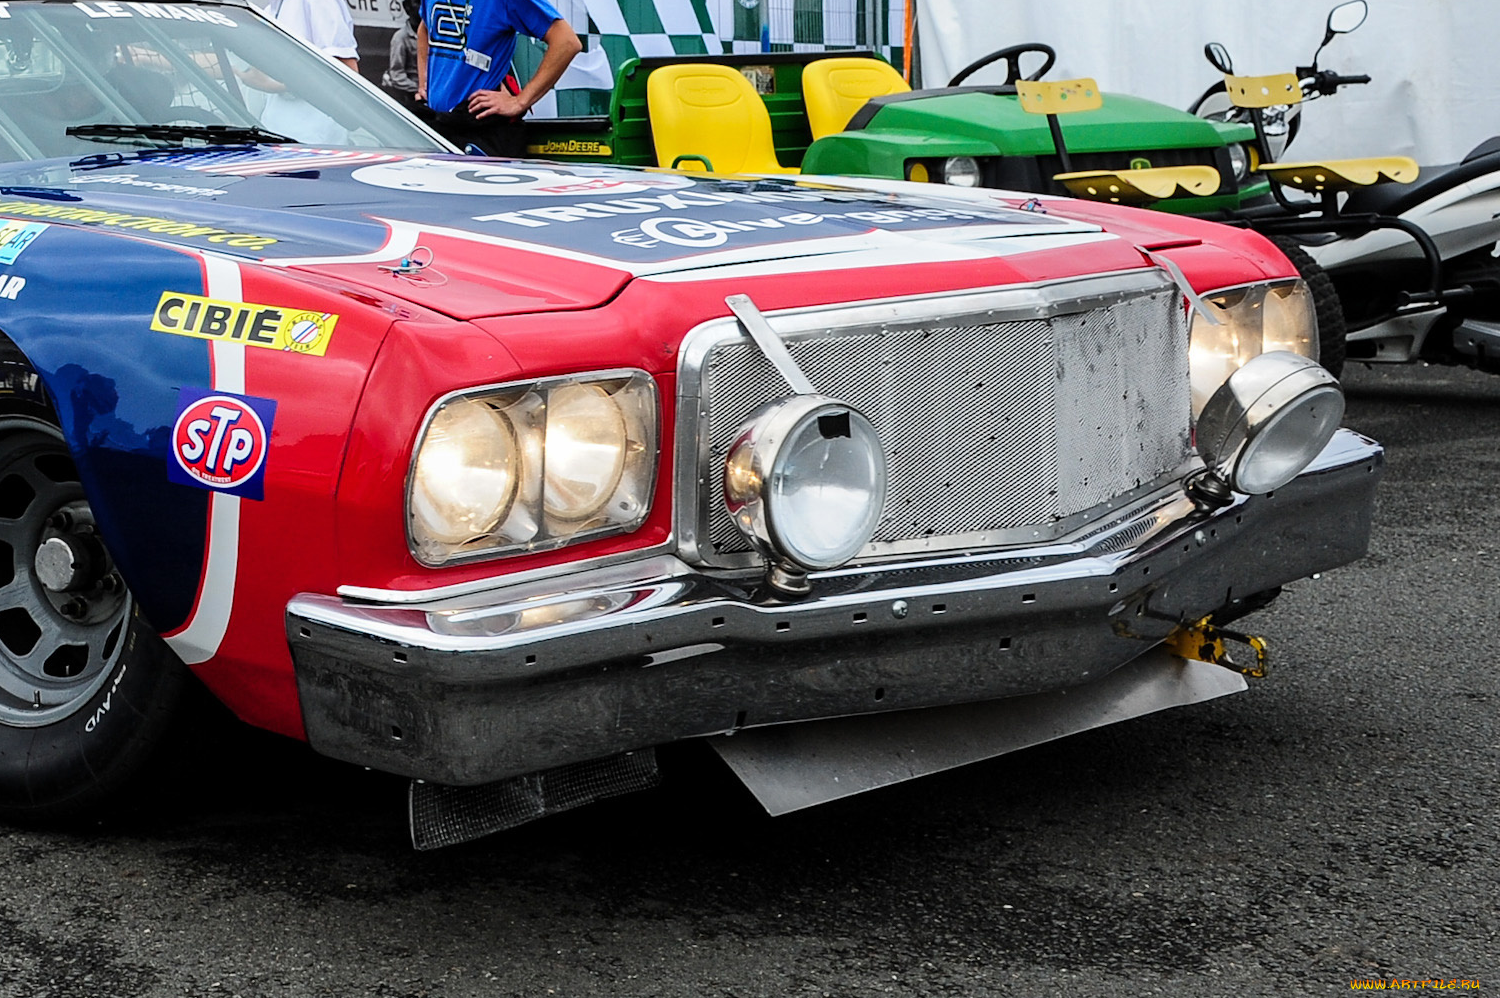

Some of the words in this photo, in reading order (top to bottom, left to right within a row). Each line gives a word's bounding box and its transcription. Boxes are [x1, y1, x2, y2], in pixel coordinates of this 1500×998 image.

[72, 2, 134, 19] LE
[130, 2, 238, 28] MANS
[544, 140, 568, 153] JOHN
[569, 140, 600, 153] DEERE
[158, 297, 284, 344] CIBIÉ
[181, 406, 254, 472] STP
